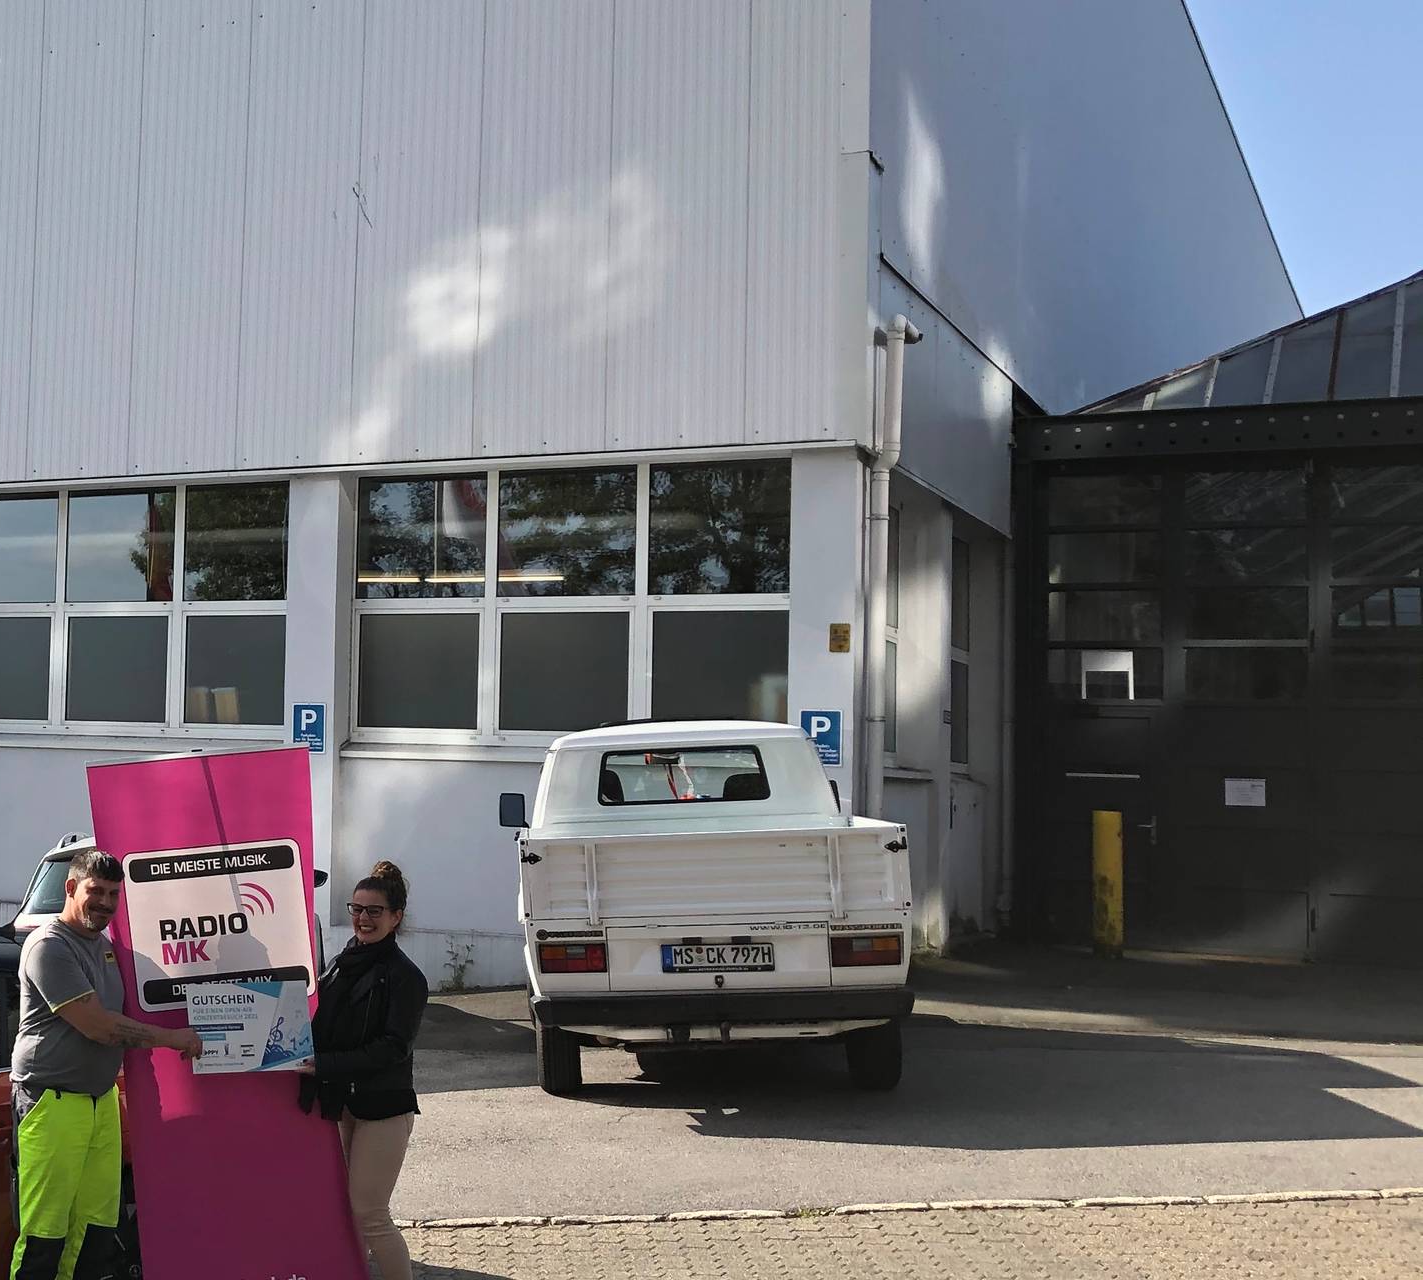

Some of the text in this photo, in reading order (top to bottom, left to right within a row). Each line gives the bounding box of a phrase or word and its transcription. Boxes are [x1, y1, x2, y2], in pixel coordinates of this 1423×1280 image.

[300, 709, 318, 731] P
[810, 716, 831, 738] P
[150, 853, 272, 876] DIE MEISTE MUSIK.
[159, 912, 249, 942] RADIO
[161, 939, 212, 966] MK
[673, 947, 694, 965] MS
[706, 947, 727, 964] CK
[730, 946, 772, 964] 797H
[192, 994, 255, 1006] GUTSCHEIN
